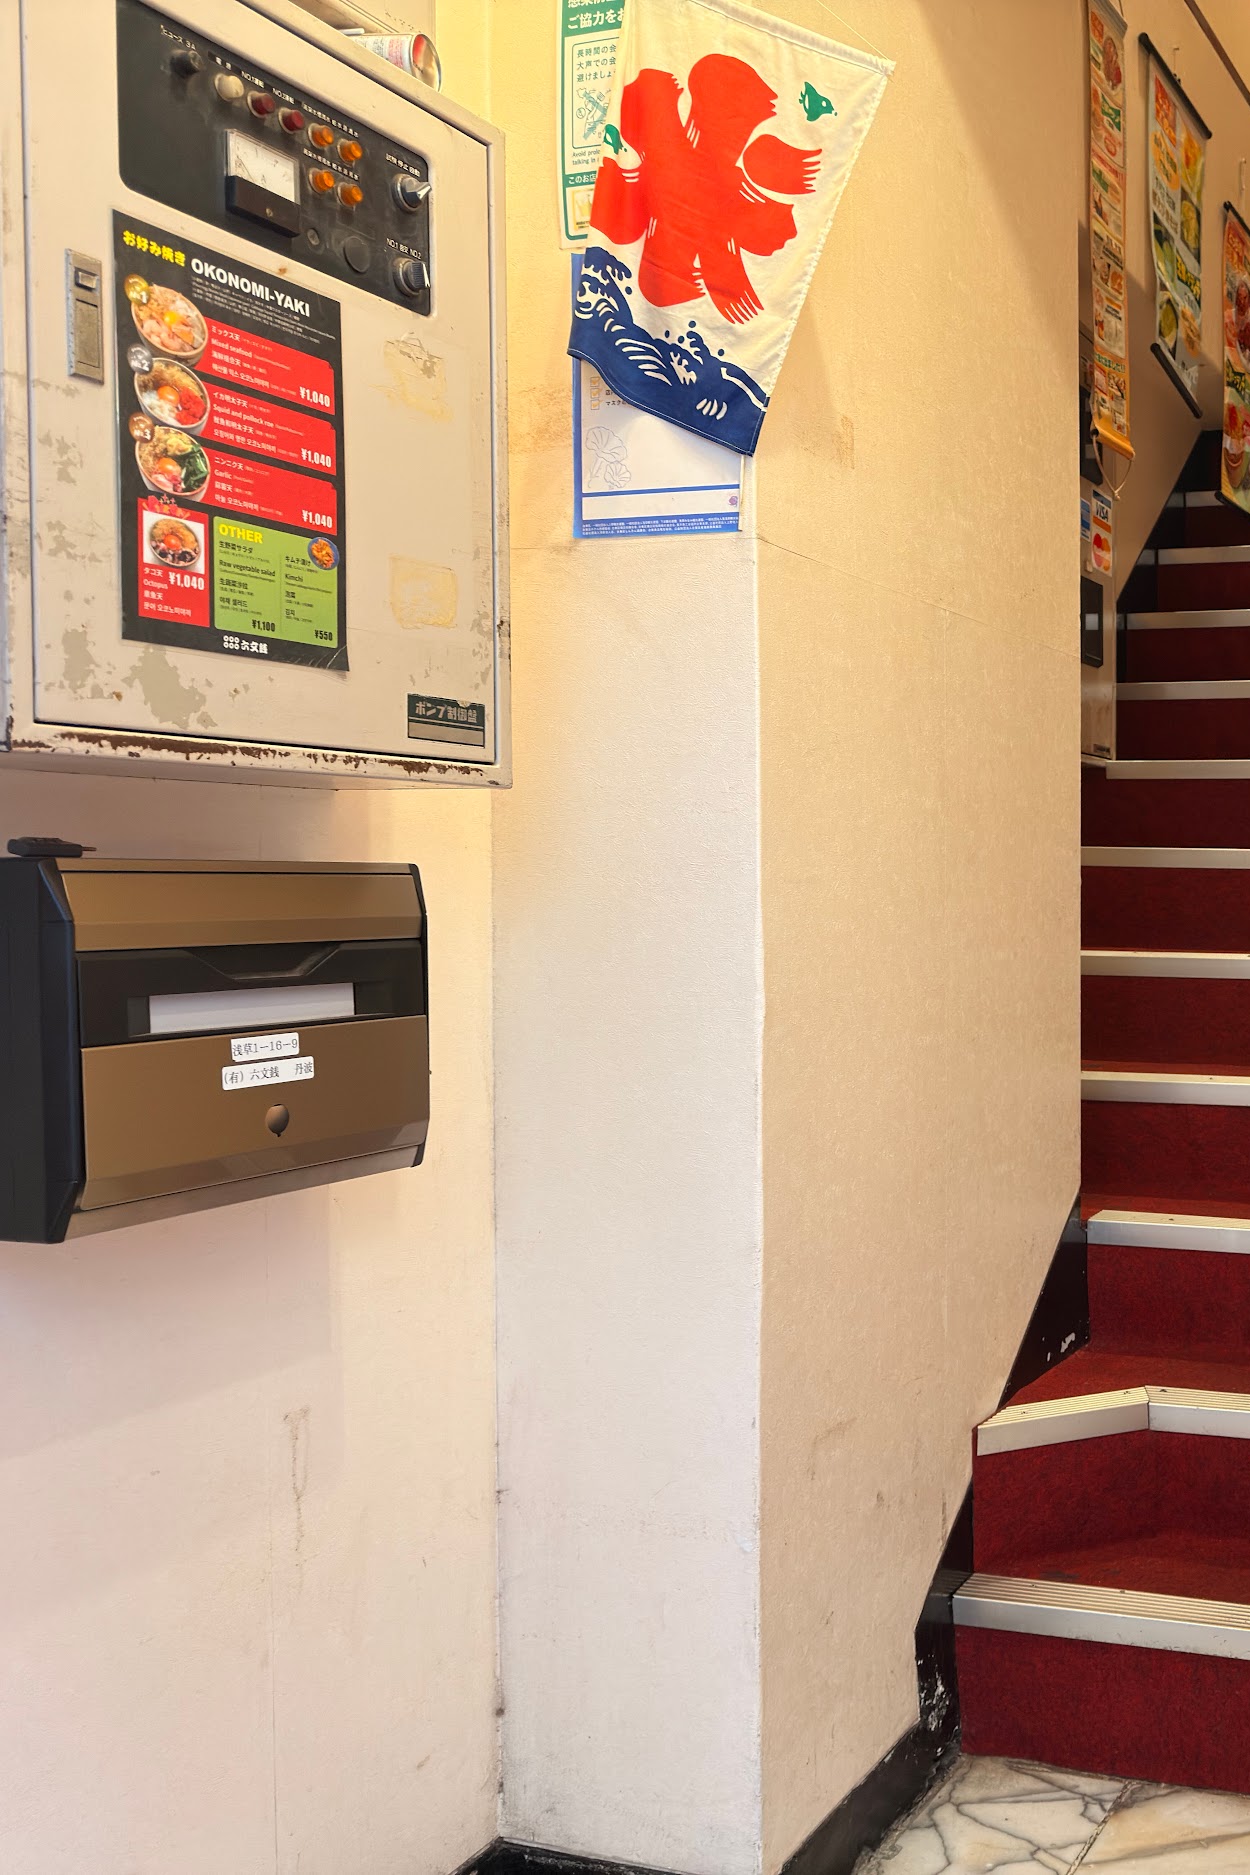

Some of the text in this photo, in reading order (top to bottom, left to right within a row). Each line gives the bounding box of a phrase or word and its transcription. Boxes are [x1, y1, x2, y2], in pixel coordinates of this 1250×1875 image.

[577, 70, 616, 83] 避けましょ
[122, 230, 187, 268] お好み焼き
[191, 258, 311, 318] OKONOMI-YAKI
[211, 325, 241, 342] ミックス天
[218, 523, 263, 545] OTHER
[168, 571, 205, 591] ¥1,040
[251, 619, 276, 633] ¥1,100
[314, 629, 333, 641] ¥550
[294, 1061, 313, 1076] 丹波
